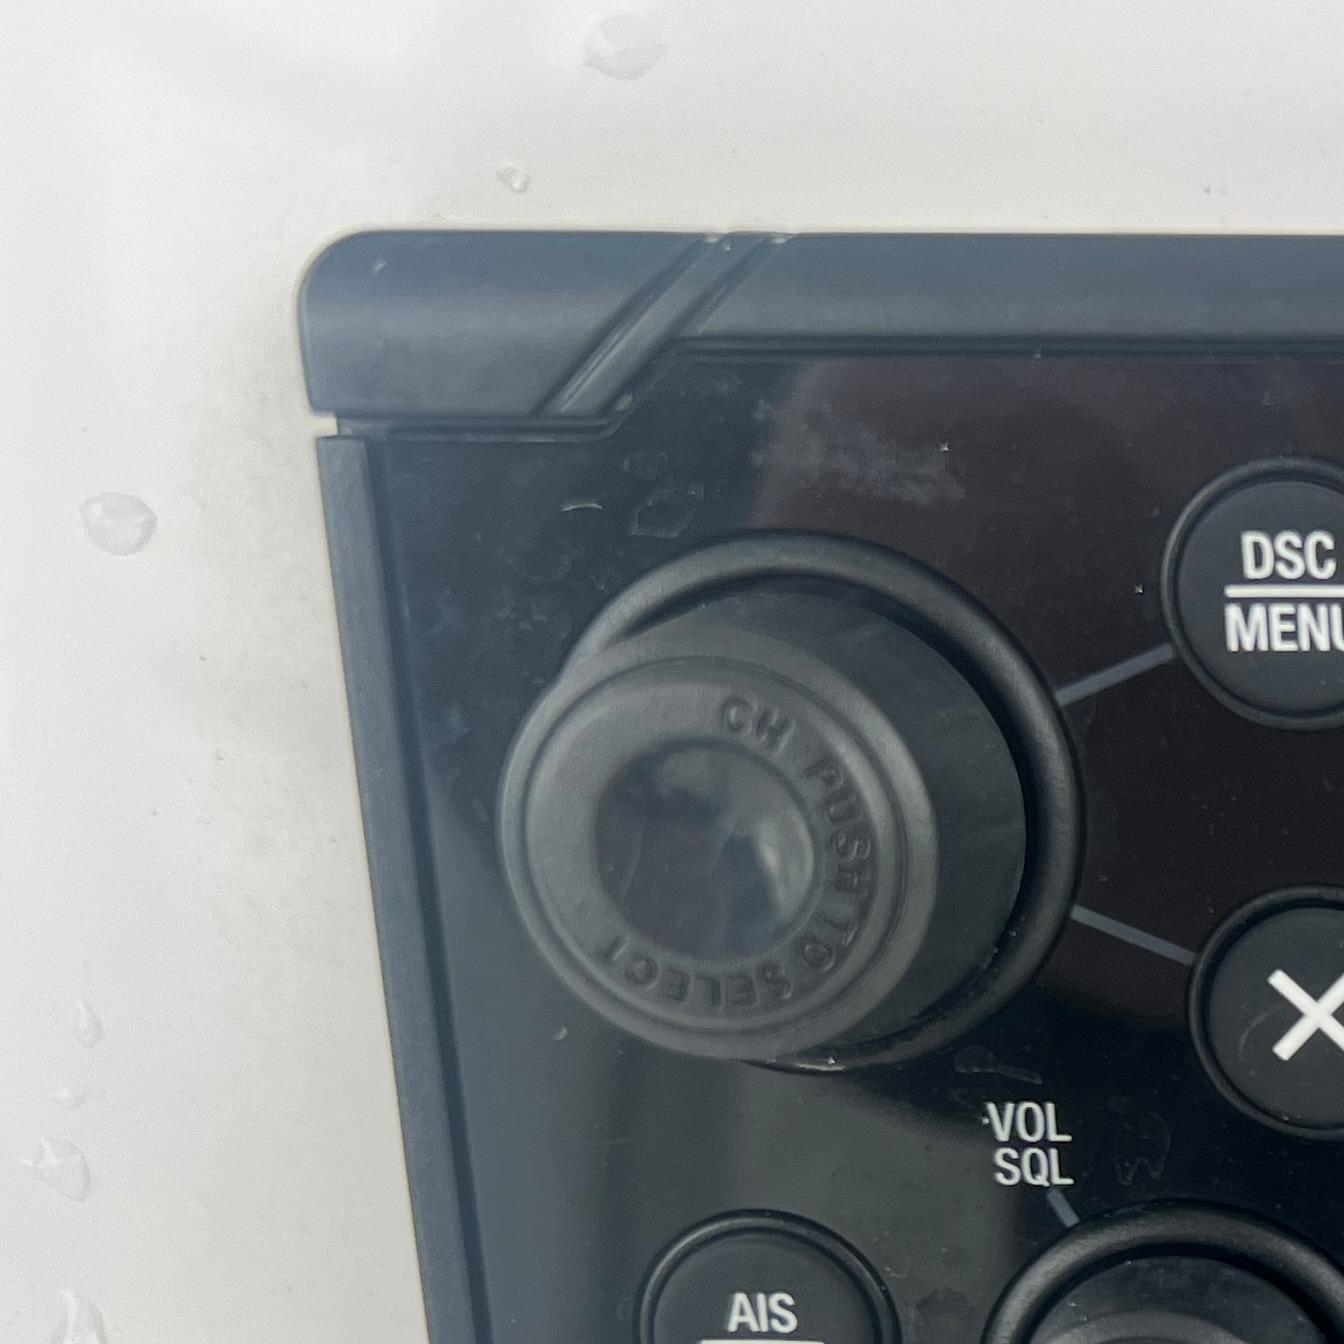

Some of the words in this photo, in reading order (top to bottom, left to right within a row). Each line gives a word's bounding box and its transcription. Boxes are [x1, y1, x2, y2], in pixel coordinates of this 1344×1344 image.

[1241, 531, 1337, 580] DSC
[804, 757, 873, 894] PUSH
[800, 914, 859, 973] TO
[604, 932, 794, 1008] SELECT
[987, 1101, 1073, 1143] VOL
[994, 1147, 1074, 1187] SQL
[727, 1291, 798, 1334] AIS
